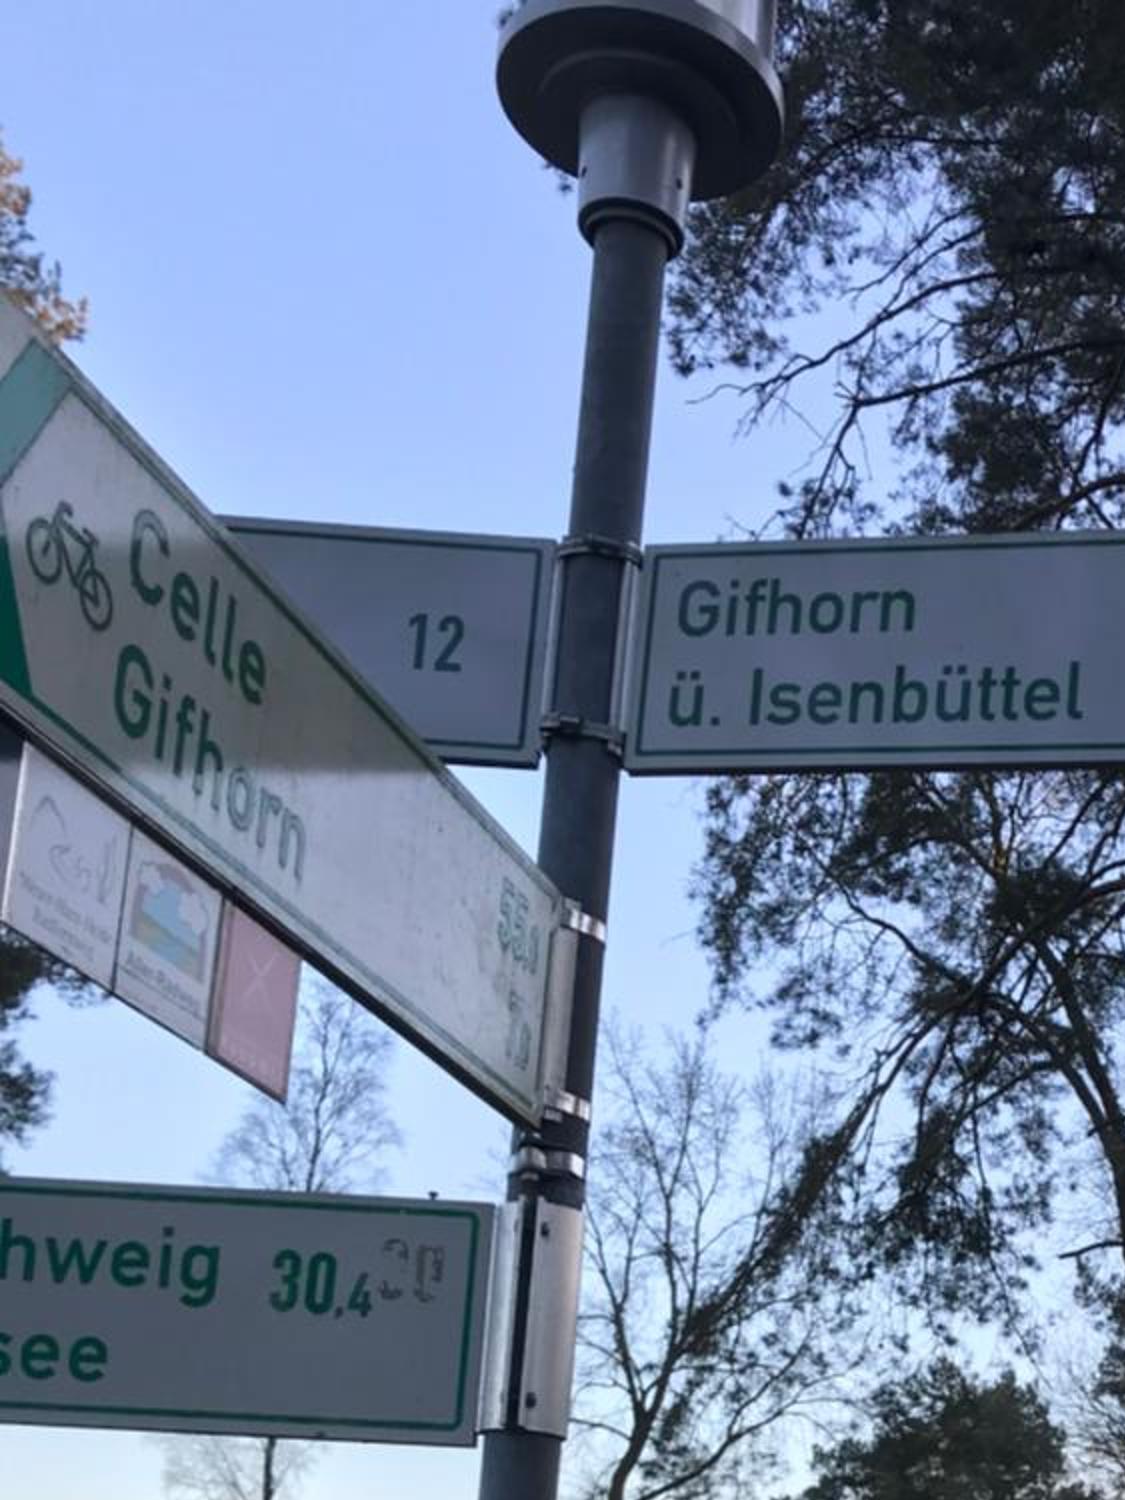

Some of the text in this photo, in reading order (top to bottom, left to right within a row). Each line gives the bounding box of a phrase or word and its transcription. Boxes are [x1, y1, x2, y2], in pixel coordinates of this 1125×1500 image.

[130, 508, 266, 706] Celle
[677, 577, 916, 637] Gifhorn
[409, 613, 465, 672] 12
[667, 660, 1084, 727] ü. Isenbüttel
[114, 644, 306, 881] Gifhorn
[268, 1248, 373, 1318] 30,4
